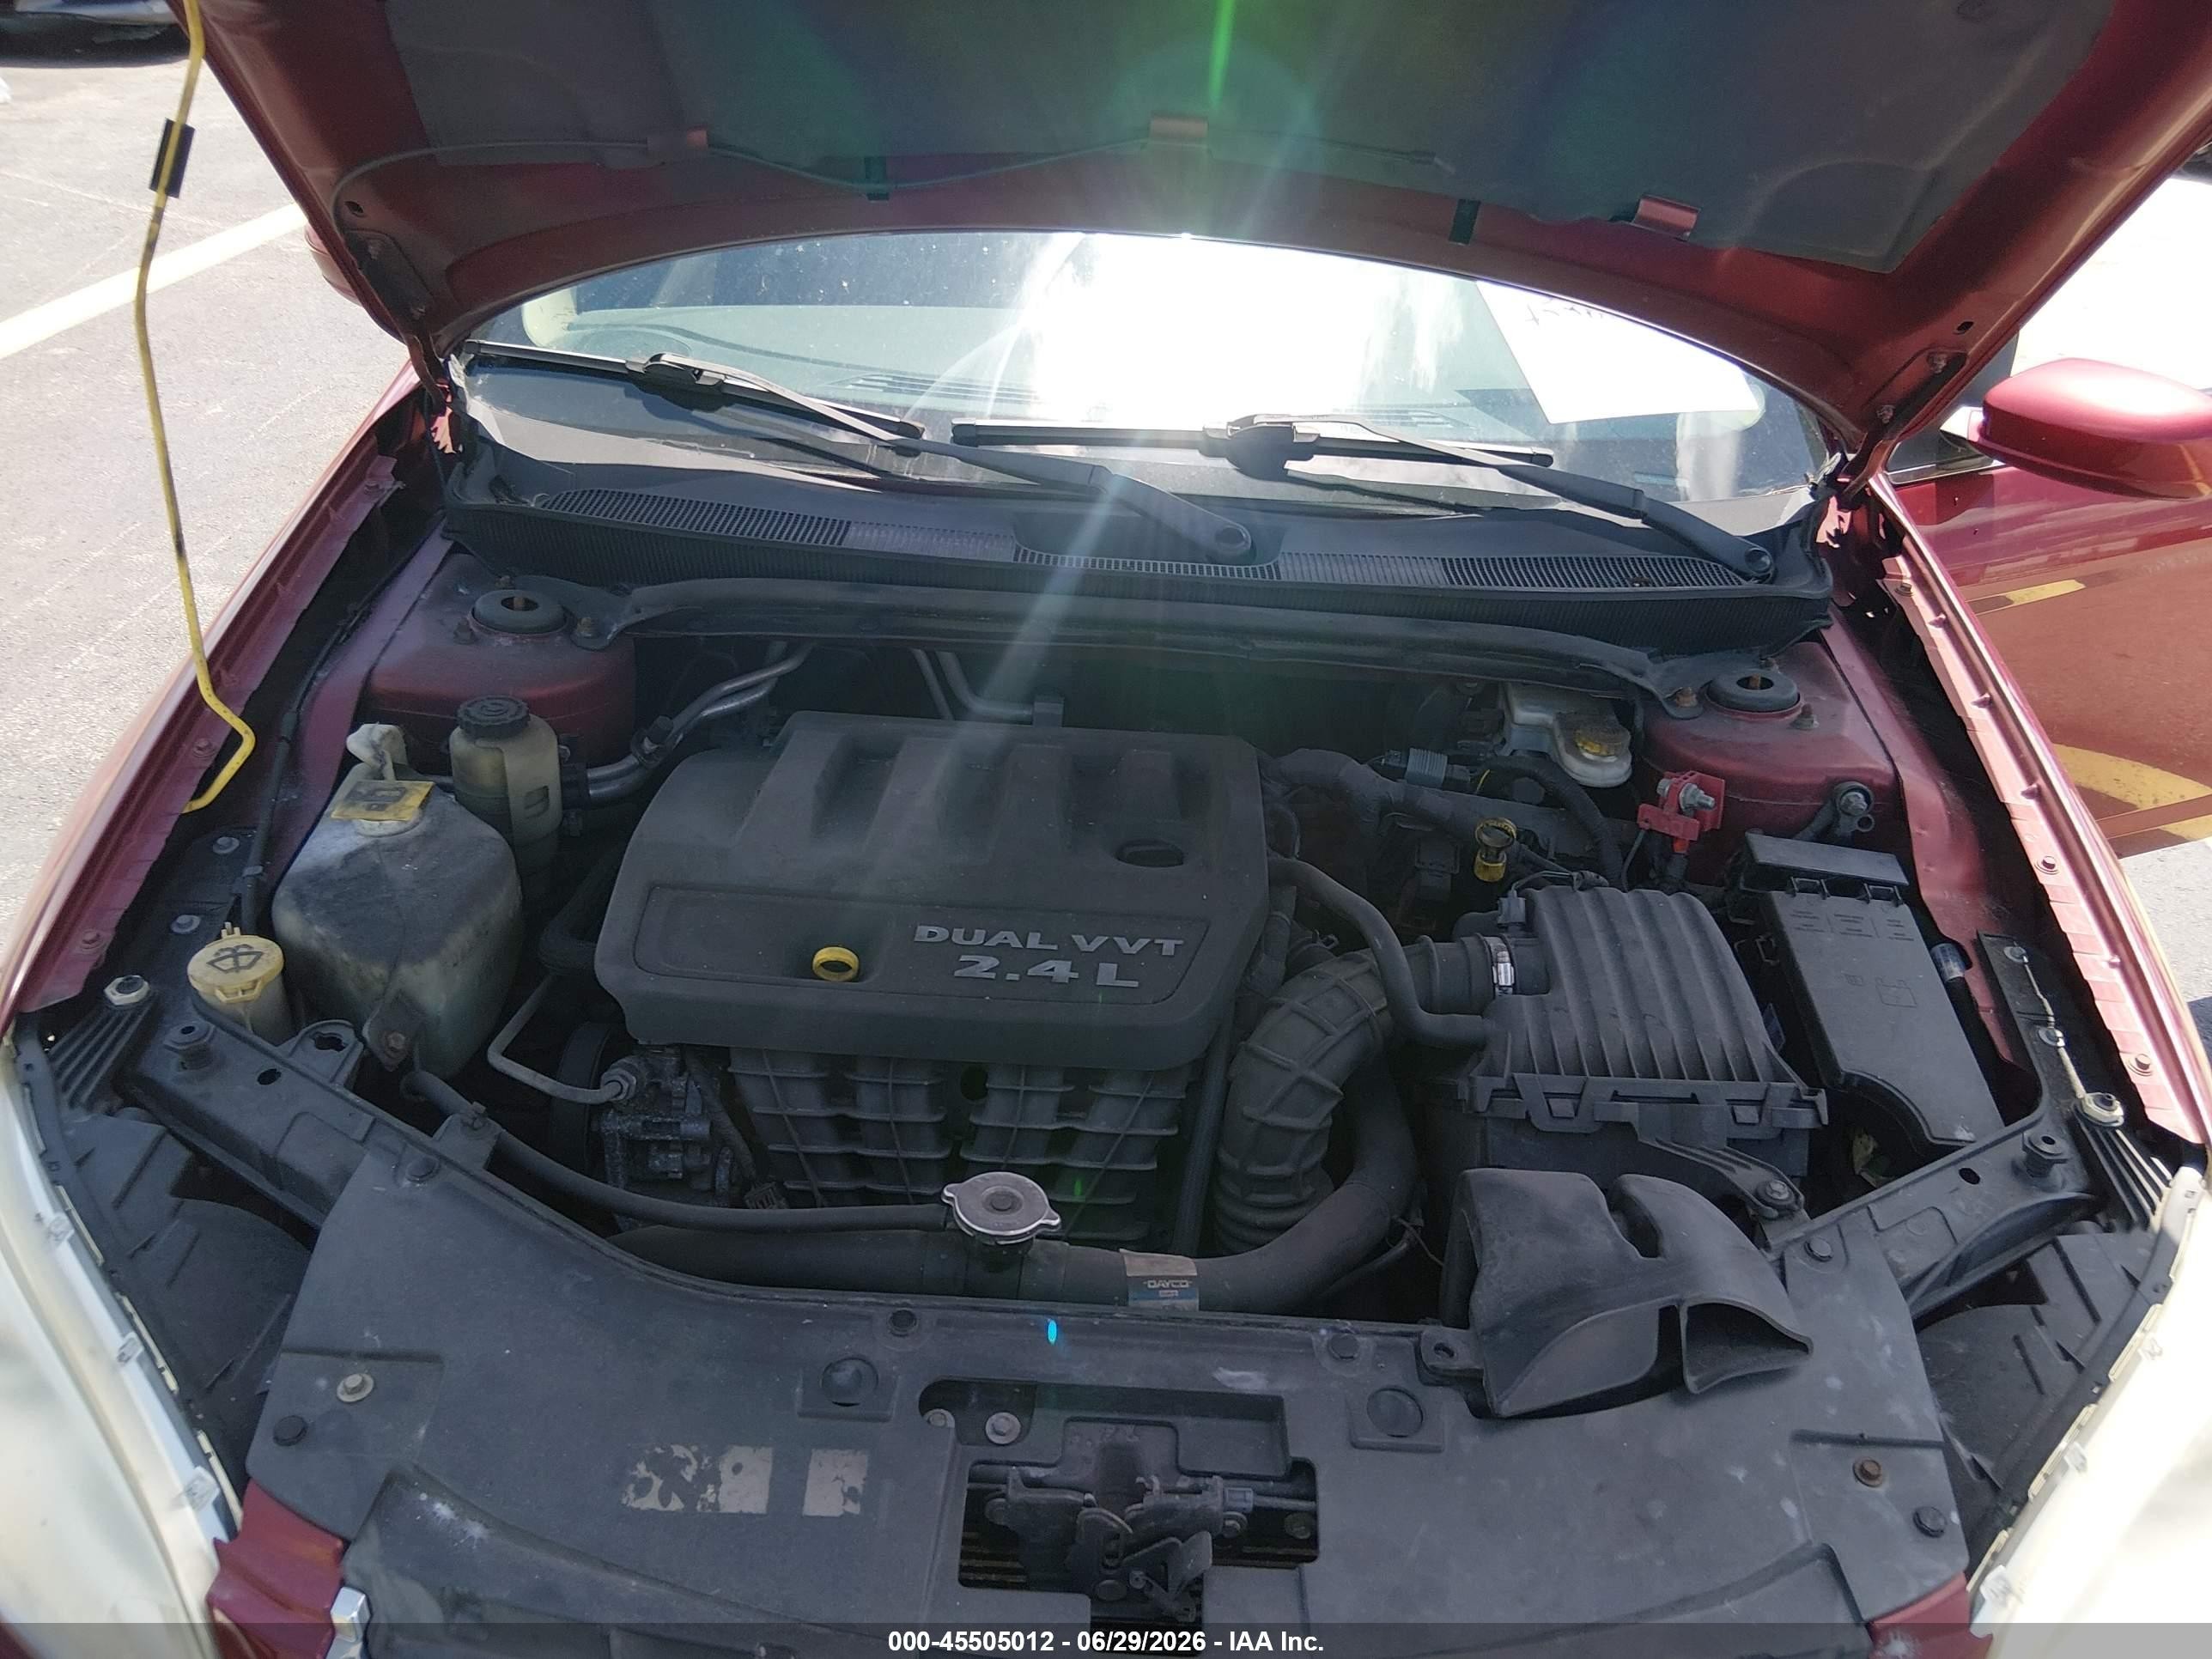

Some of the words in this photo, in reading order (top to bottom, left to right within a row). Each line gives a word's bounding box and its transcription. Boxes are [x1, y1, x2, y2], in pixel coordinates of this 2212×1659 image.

[914, 926, 1059, 950] DUAL
[1071, 934, 1184, 956] VVT
[954, 954, 1079, 983] 2.4
[1146, 1279, 1189, 1288] DAYCO
